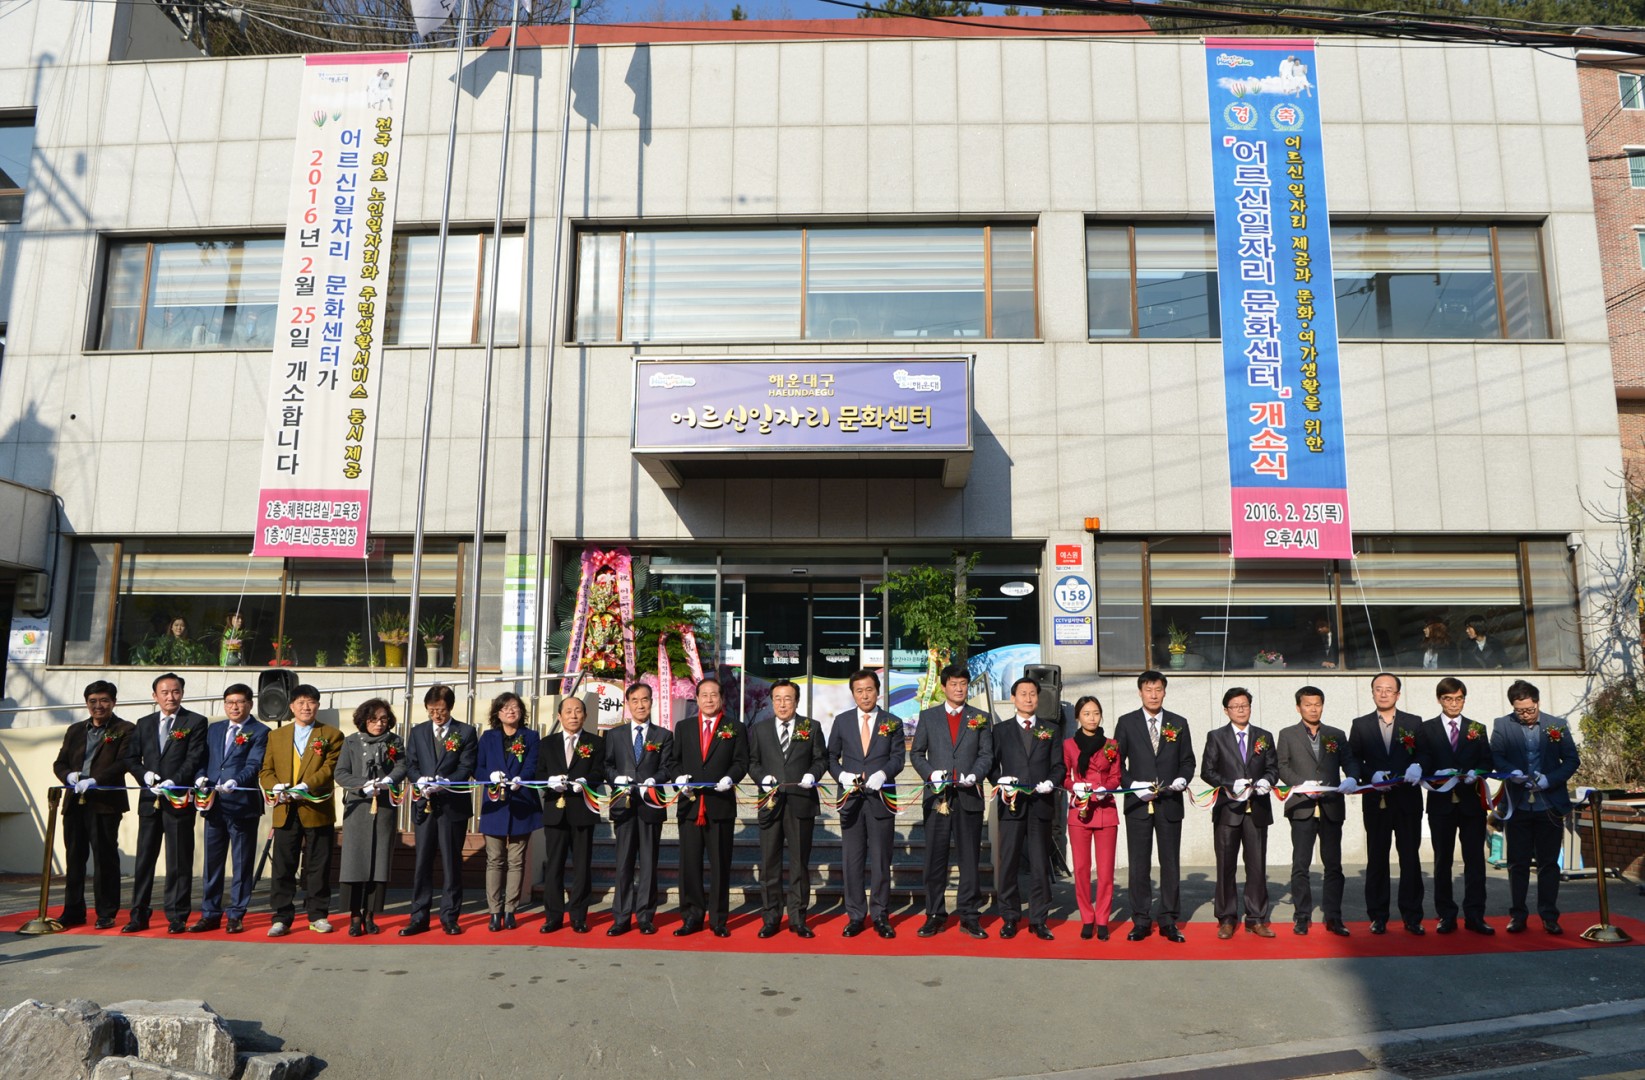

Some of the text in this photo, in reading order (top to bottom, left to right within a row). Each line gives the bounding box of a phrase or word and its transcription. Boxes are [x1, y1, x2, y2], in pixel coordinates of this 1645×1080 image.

[1232, 106, 1295, 124] 경 축
[375, 117, 393, 147] 전국
[370, 151, 389, 182] 최초
[361, 187, 386, 280] 노인일자리와
[317, 128, 363, 391] 어르신일자리 문화센터가
[277, 149, 324, 475] 2016년 2월 25일 개소합니다
[349, 286, 377, 398] 주민생활서비스
[1291, 235, 1313, 283] 제공과
[1304, 419, 1324, 453] 위한
[768, 373, 836, 389] 해운대구
[768, 388, 835, 398] HAEUNDAEGU
[670, 403, 932, 433] 어르신일자리 문화센터
[1250, 402, 1288, 480] 개소식
[1244, 503, 1343, 522] 2016. 2. 25(목)
[1264, 530, 1319, 548] 오후4시
[1061, 590, 1086, 601] 158
